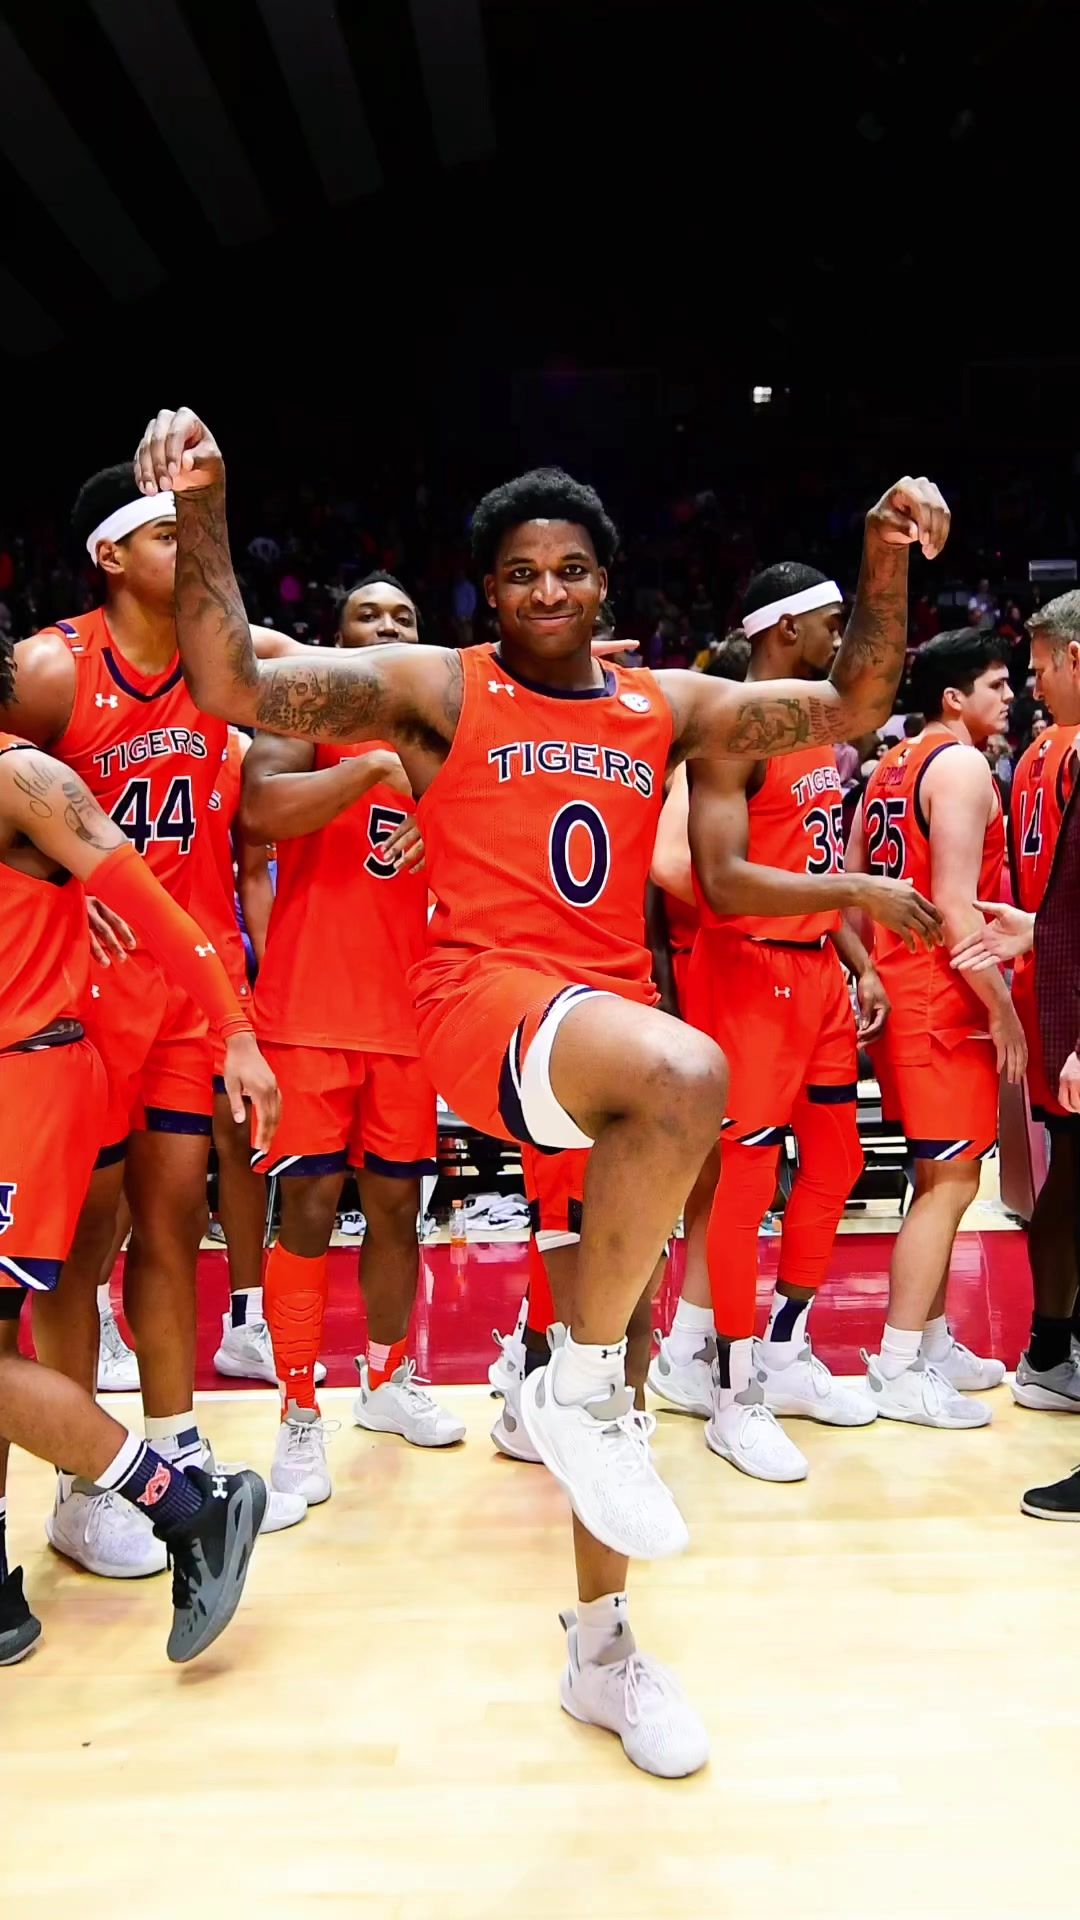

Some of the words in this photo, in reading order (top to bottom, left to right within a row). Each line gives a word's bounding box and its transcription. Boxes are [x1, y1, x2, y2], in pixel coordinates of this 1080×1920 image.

[93, 728, 208, 778] TIGERS
[488, 741, 655, 798] TIGERS
[108, 775, 197, 856] 44
[363, 804, 408, 880] 5
[548, 799, 610, 908] 0
[865, 797, 907, 880] 25
